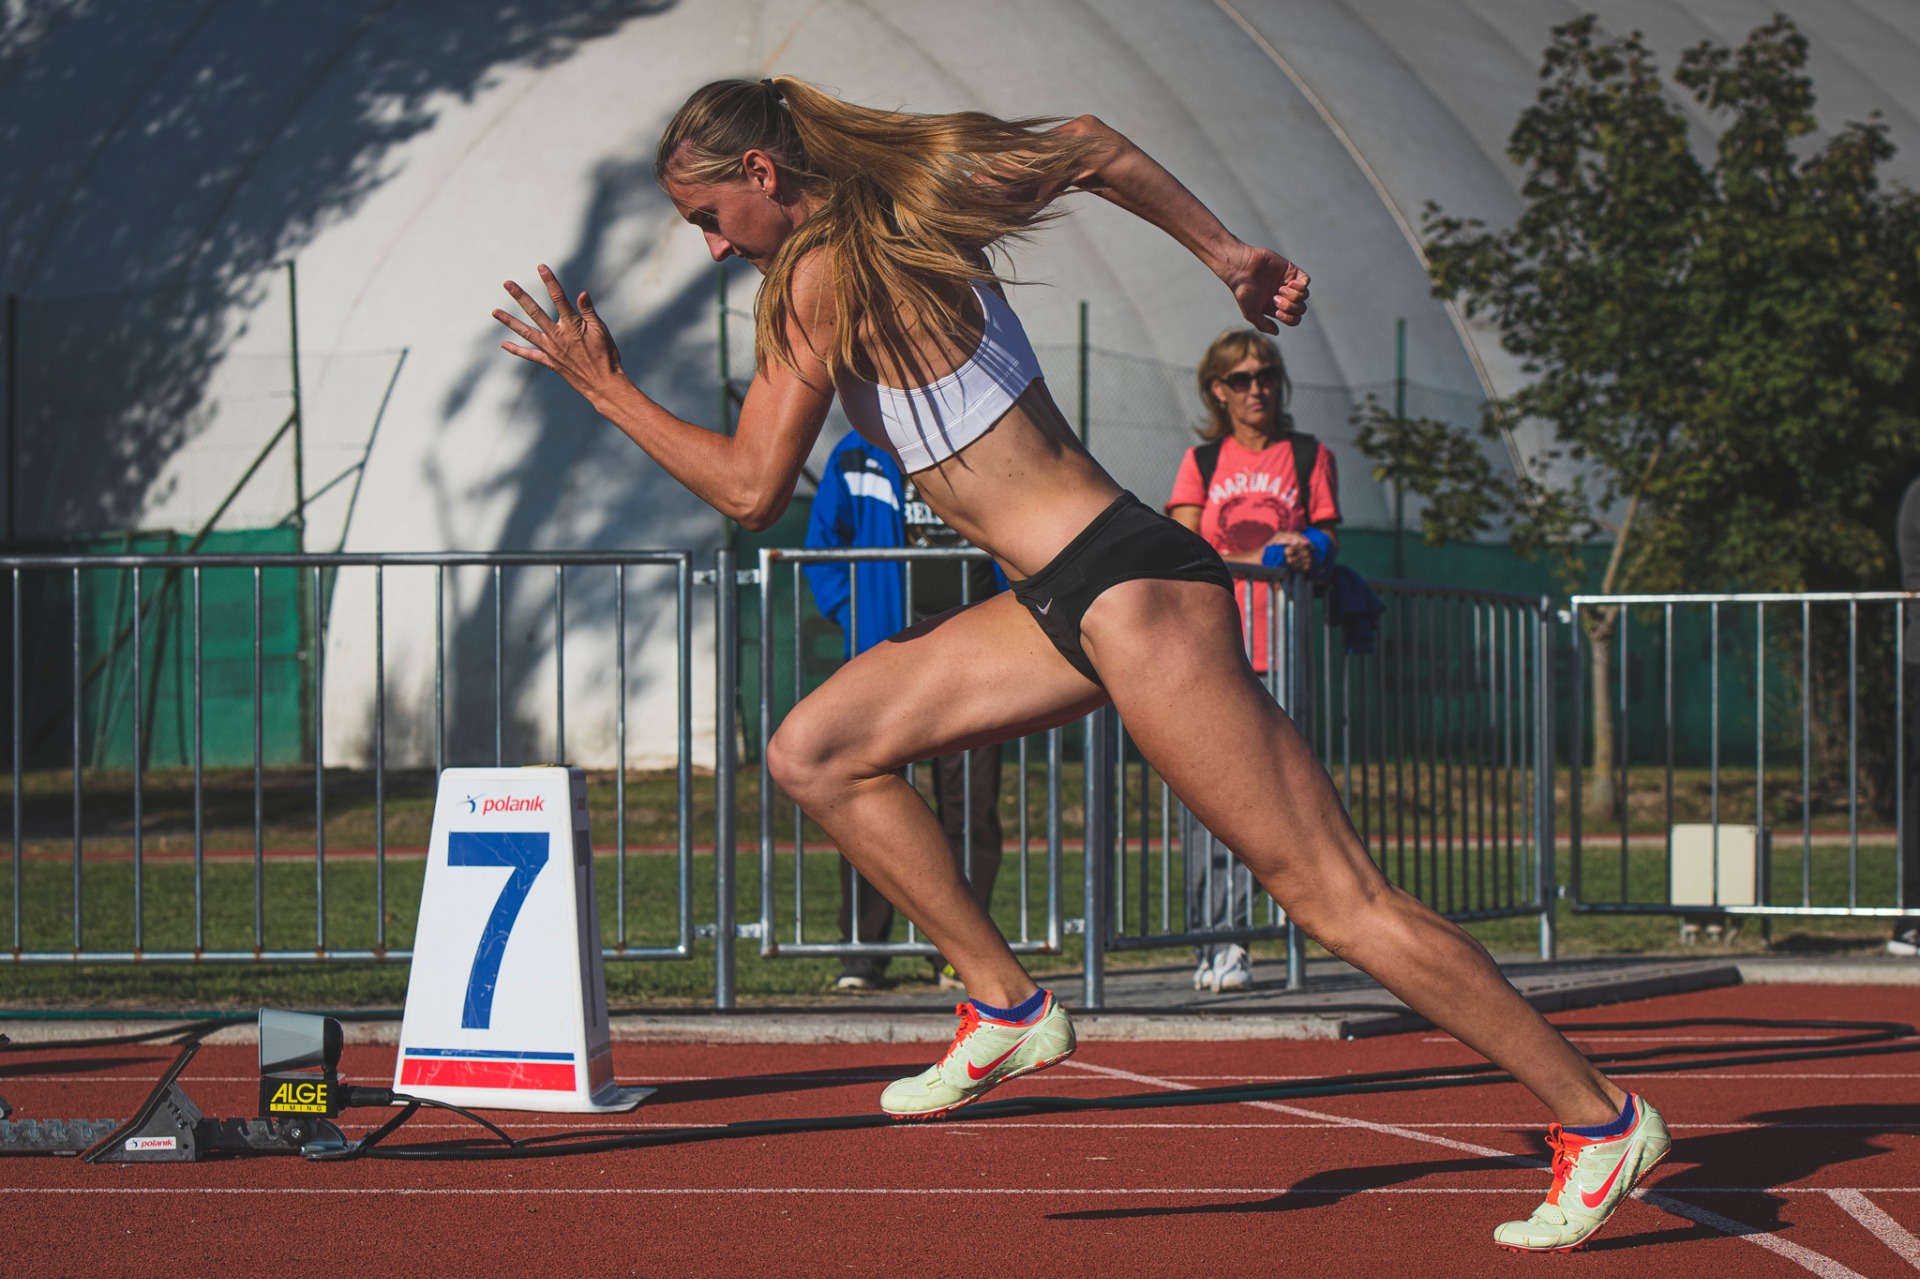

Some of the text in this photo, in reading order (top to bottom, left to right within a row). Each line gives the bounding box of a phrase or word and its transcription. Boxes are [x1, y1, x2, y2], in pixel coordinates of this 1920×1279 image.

[482, 795, 545, 816] polanik
[447, 832, 550, 1029] 7
[271, 1083, 327, 1104] ALGE
[141, 1139, 173, 1148] polanik
